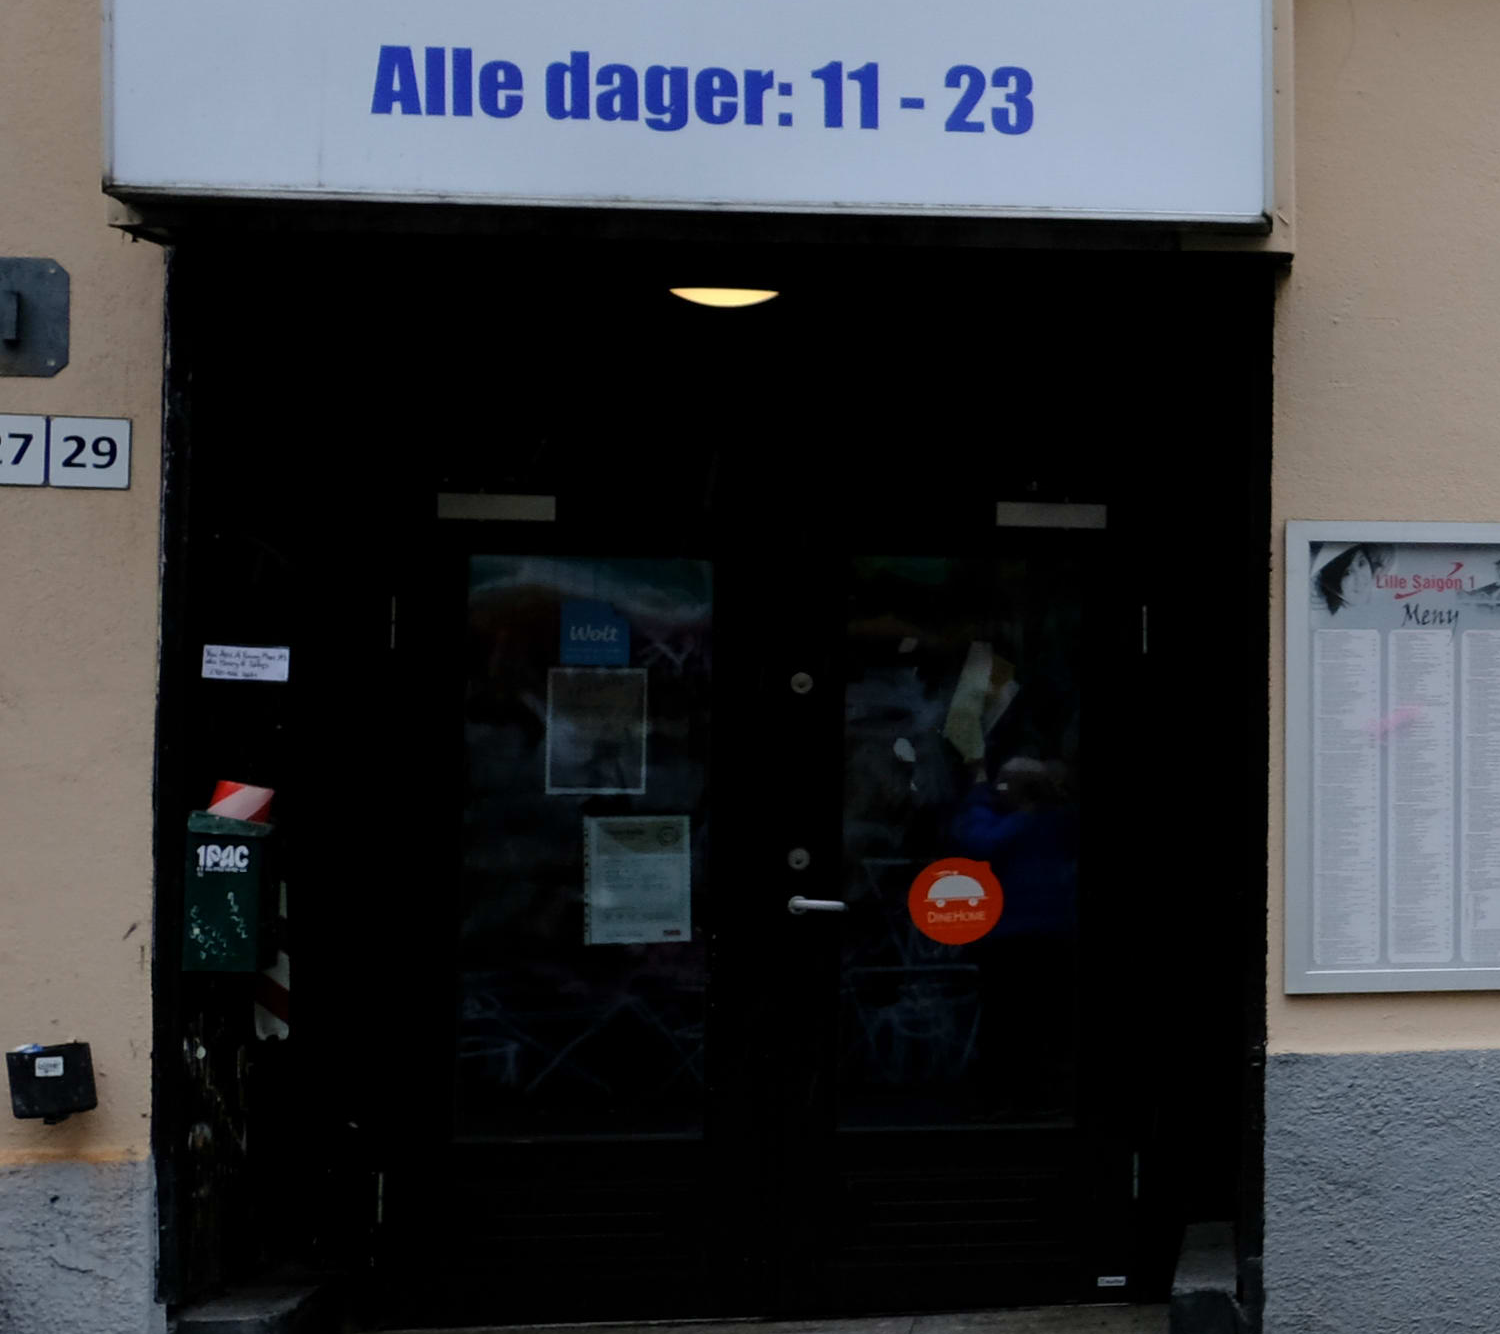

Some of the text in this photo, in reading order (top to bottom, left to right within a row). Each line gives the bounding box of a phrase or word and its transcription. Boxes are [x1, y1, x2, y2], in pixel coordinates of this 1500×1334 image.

[370, 42, 526, 121] Alle
[543, 49, 796, 135] dager:
[808, 59, 881, 132] 11
[943, 62, 1036, 138] 23
[0, 433, 34, 465] 7
[61, 435, 118, 469] 29
[1376, 574, 1476, 593] Lille Saigon 1
[568, 623, 619, 643] Wolt
[1401, 603, 1460, 635] Meny
